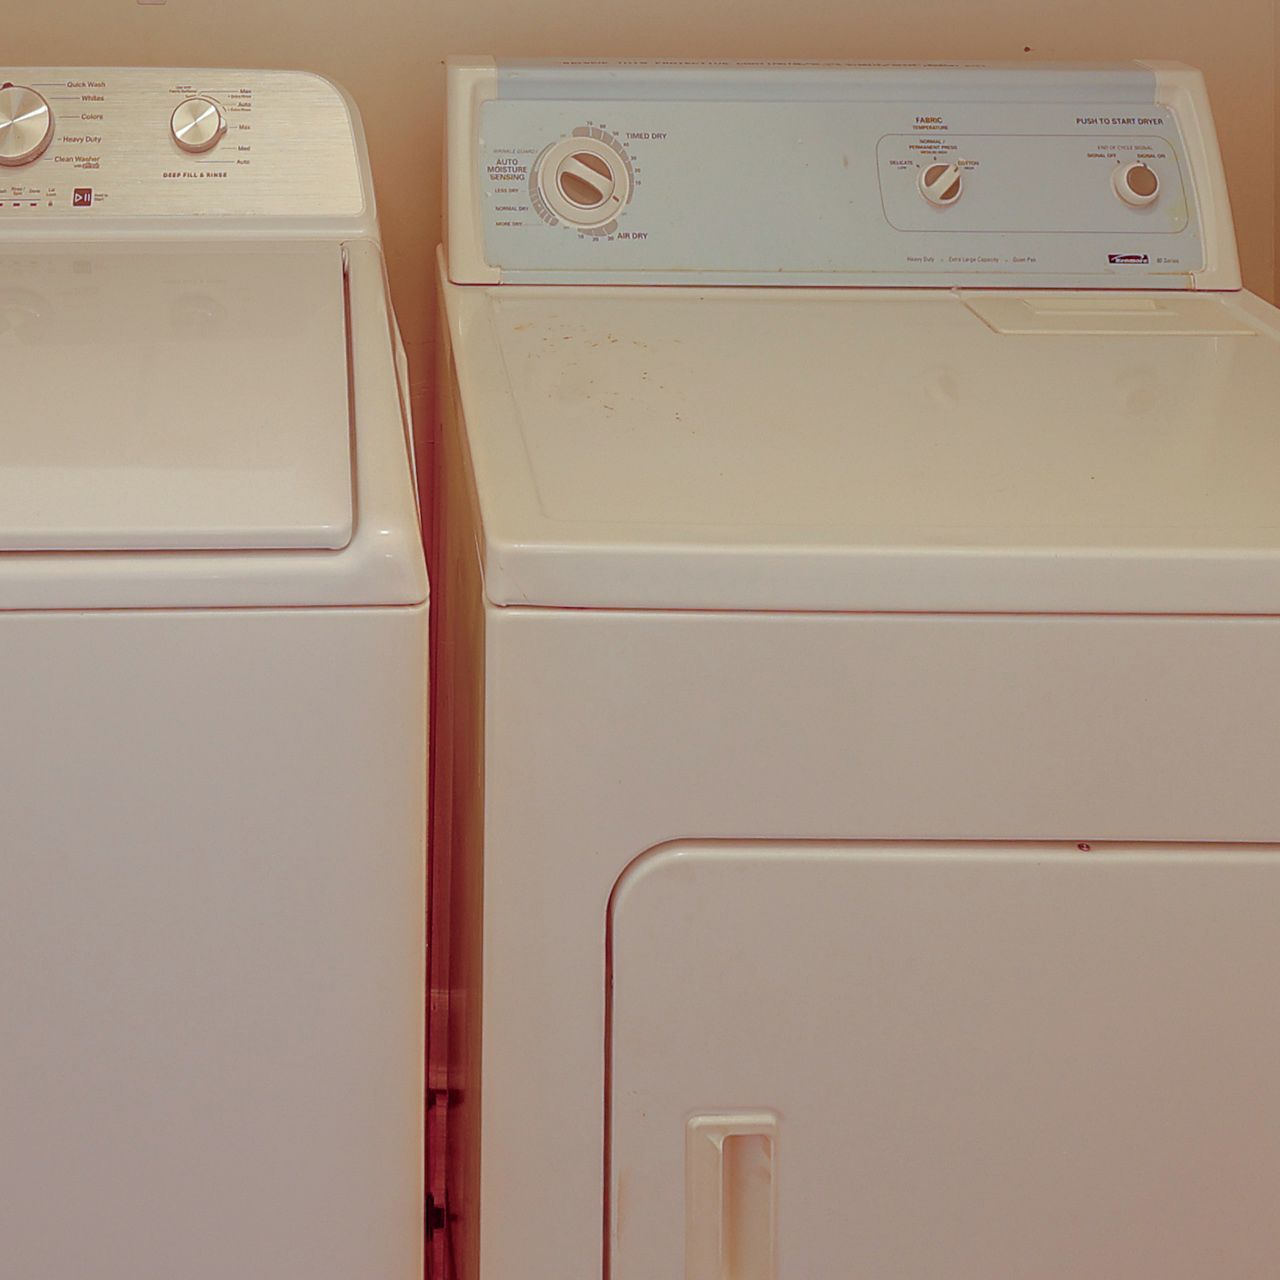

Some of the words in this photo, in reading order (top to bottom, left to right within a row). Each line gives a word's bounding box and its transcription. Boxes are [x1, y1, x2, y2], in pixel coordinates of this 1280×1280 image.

[915, 116, 943, 124] FABRIC
[62, 136, 84, 144] Heavy
[85, 136, 102, 144] Duty
[626, 132, 650, 140] TIMED
[651, 132, 667, 140] DRY
[54, 155, 74, 163] Clean
[496, 158, 519, 166] AUTO
[490, 173, 525, 181] SENSING
[617, 232, 630, 240] AIR
[631, 232, 648, 240] DRY
